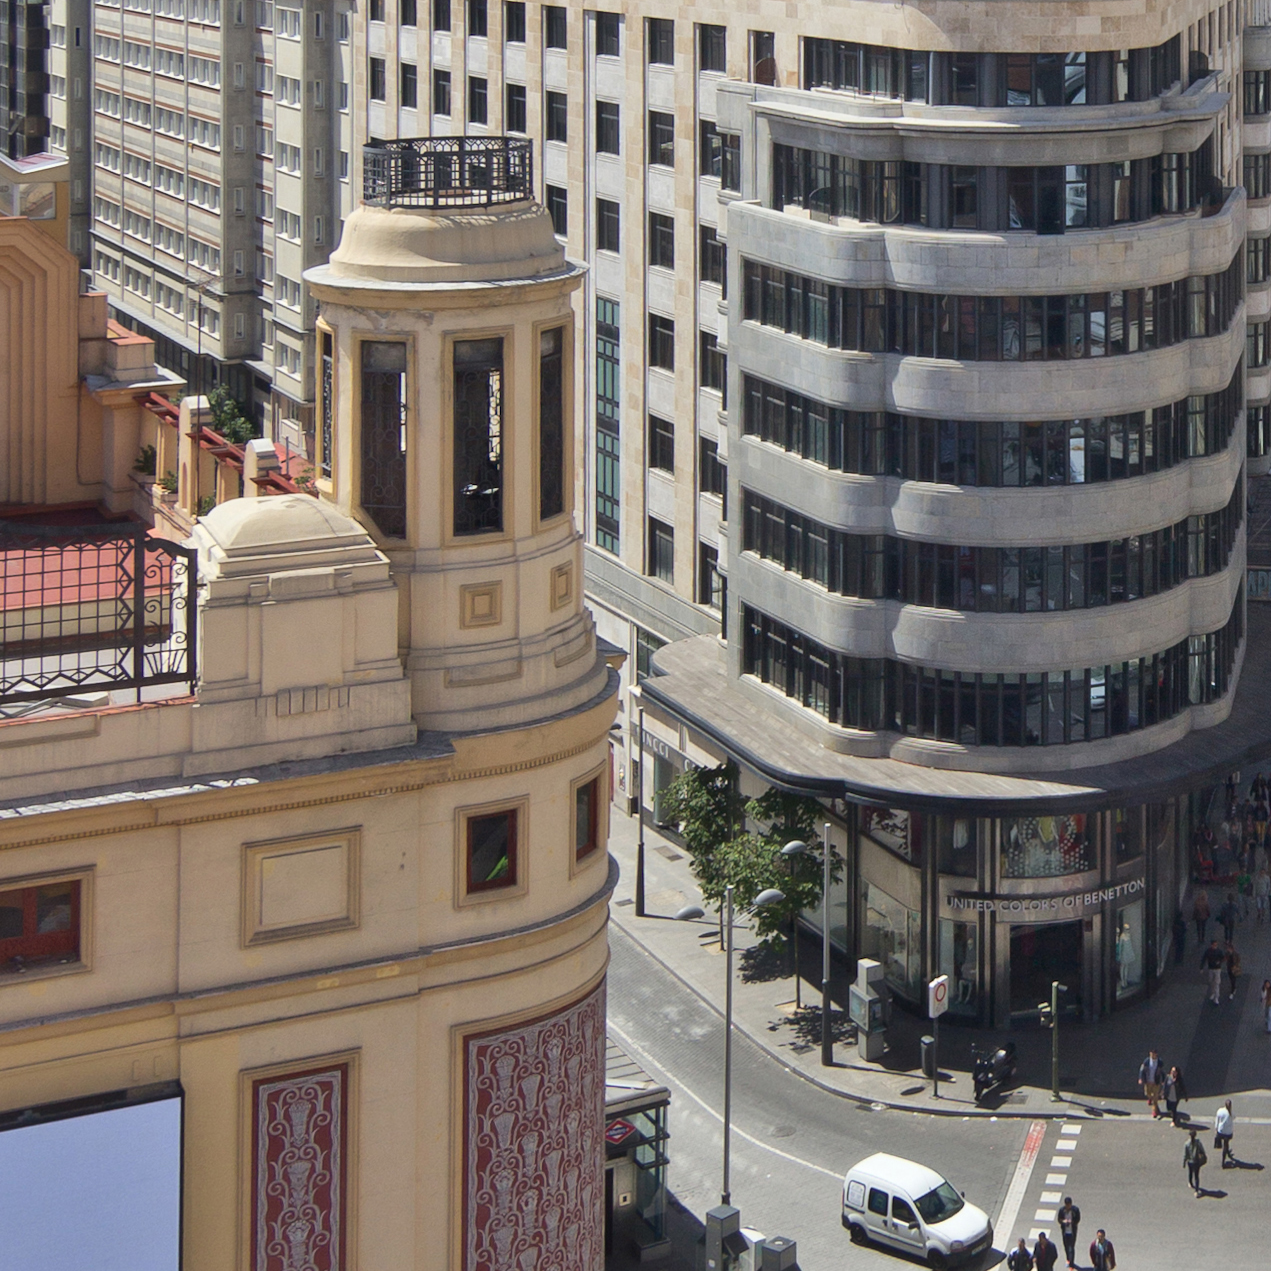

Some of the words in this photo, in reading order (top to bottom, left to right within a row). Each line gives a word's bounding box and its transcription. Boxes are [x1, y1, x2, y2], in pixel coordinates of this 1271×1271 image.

[947, 896, 994, 912] UNITED
[999, 898, 1059, 913] COLORS
[1063, 895, 1081, 908] OF
[1084, 877, 1146, 906] BENETTON
